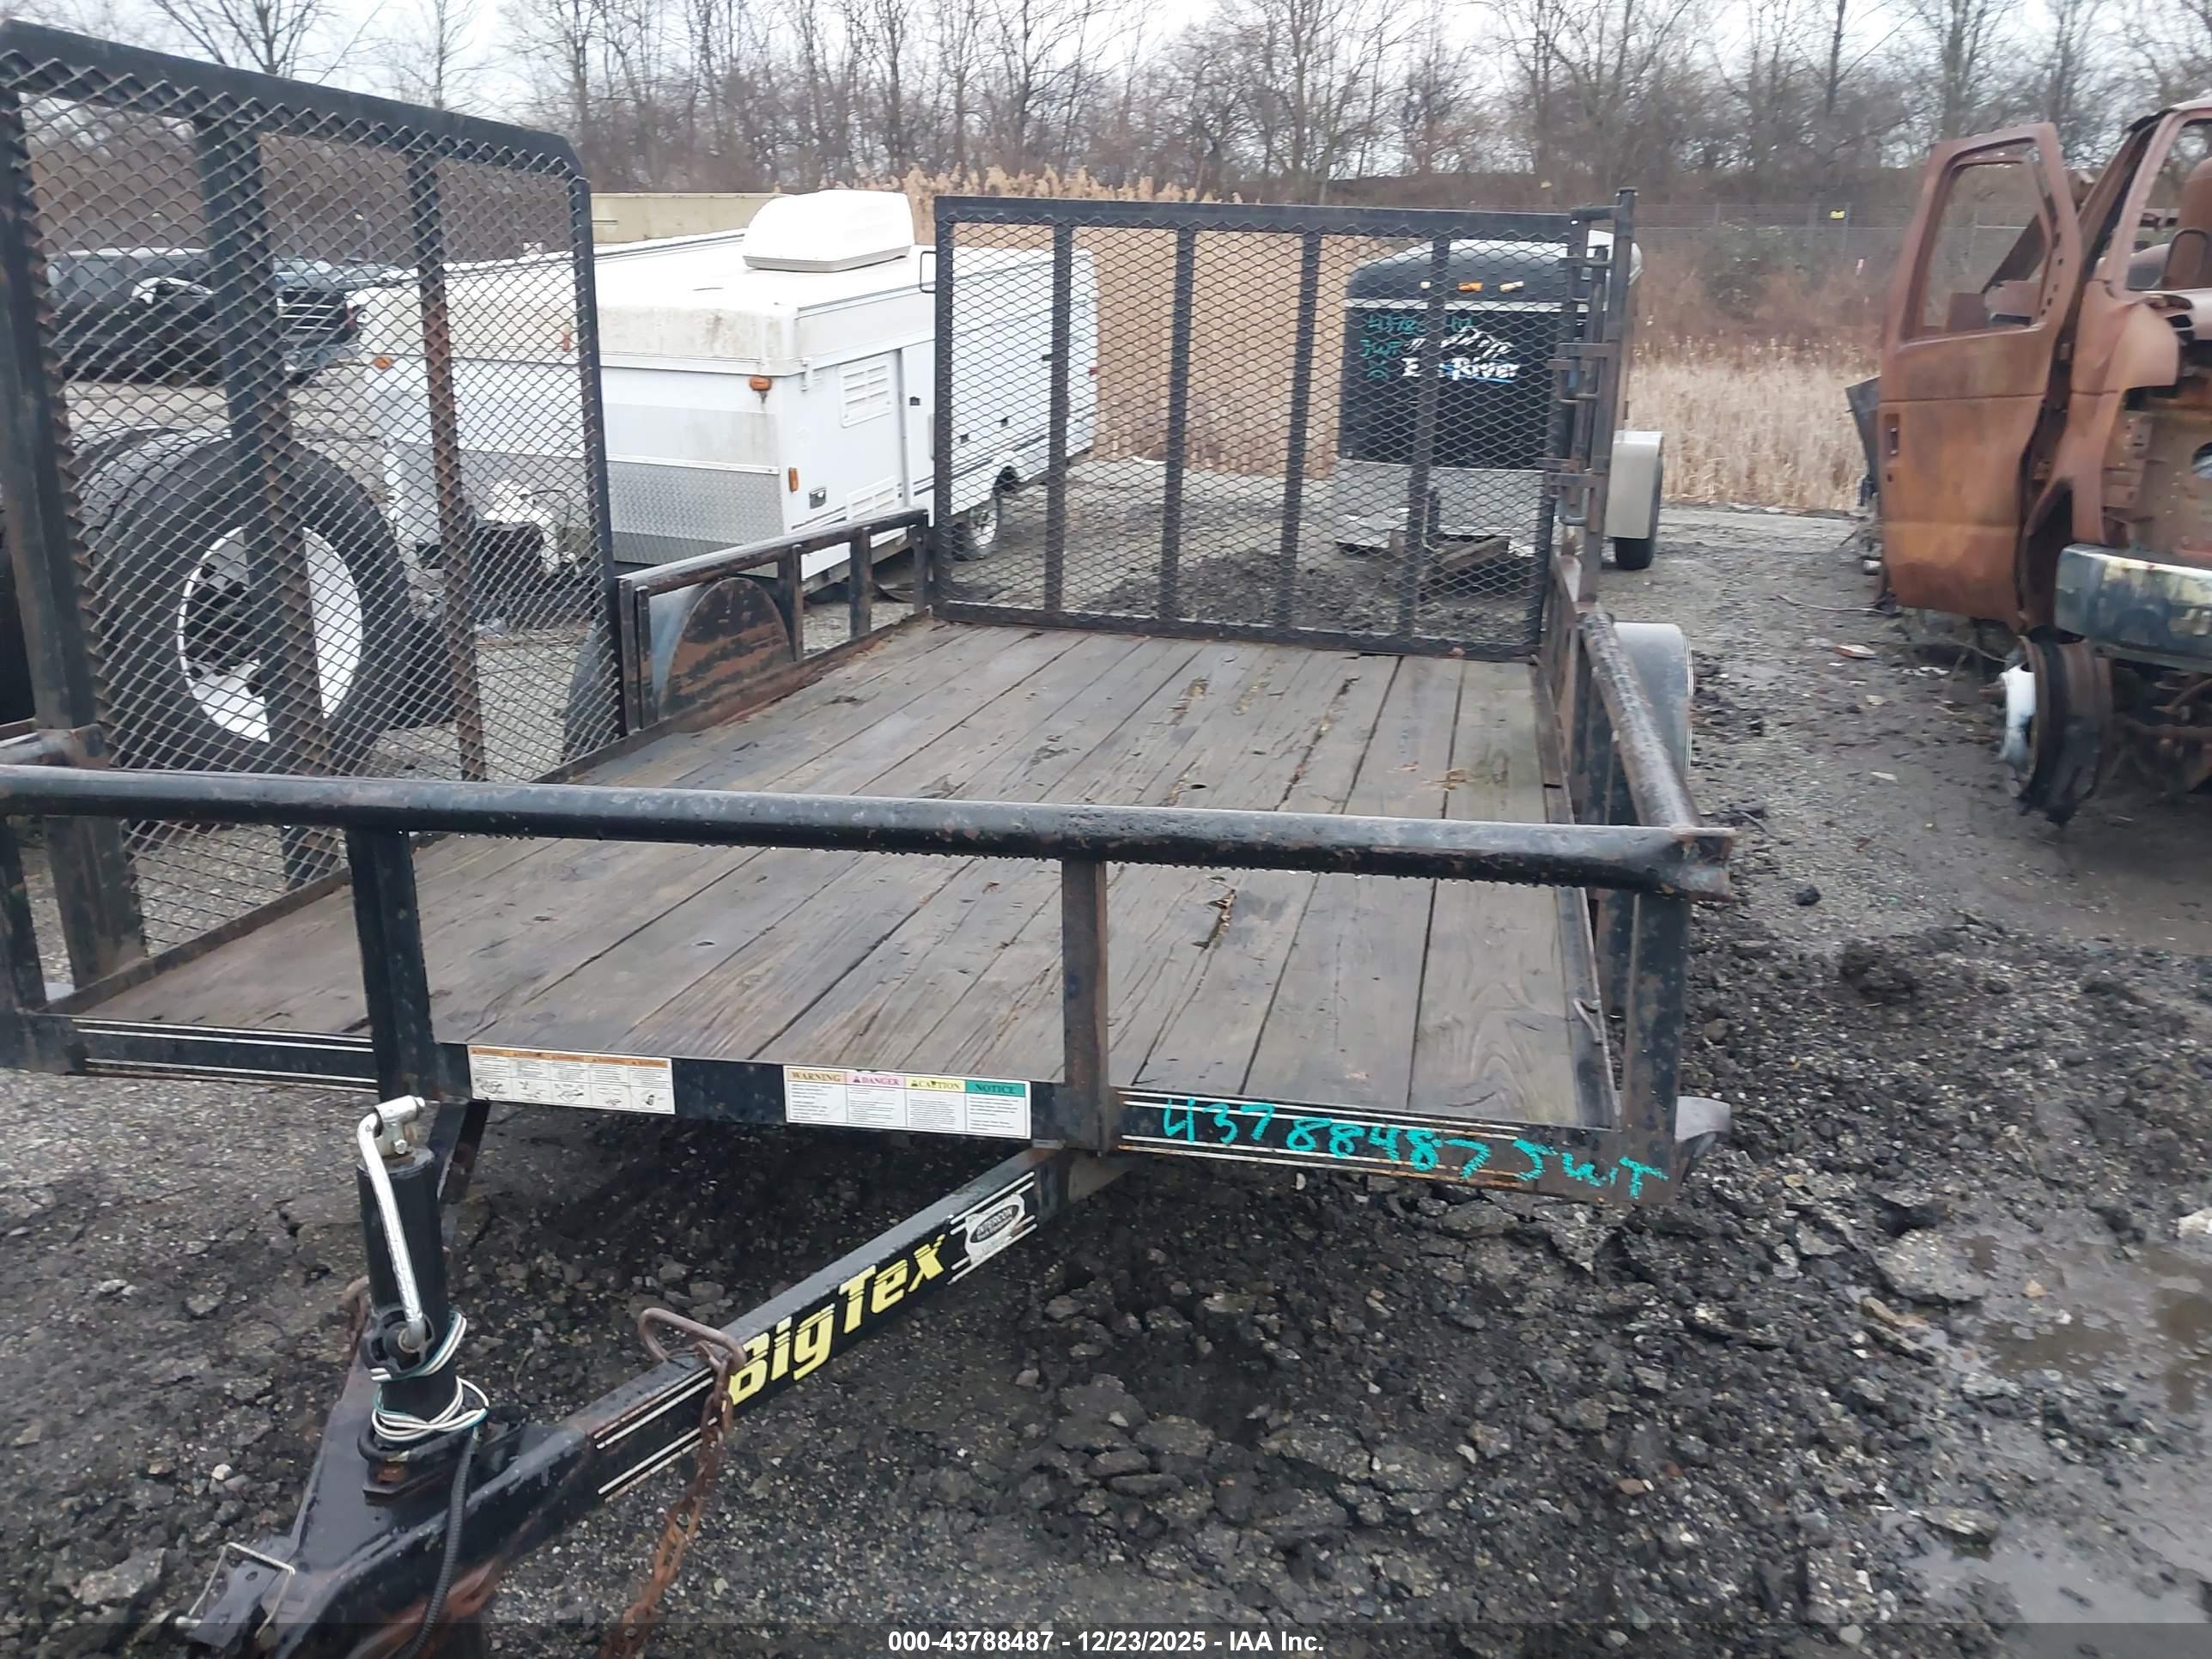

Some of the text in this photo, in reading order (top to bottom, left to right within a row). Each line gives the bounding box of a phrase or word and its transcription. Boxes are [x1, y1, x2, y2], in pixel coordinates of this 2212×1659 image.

[791, 1071, 841, 1082] WARNING
[862, 1075, 900, 1085] DANGER
[975, 1084, 1016, 1094] NOTICE
[1162, 1096, 1492, 1181] 43788487
